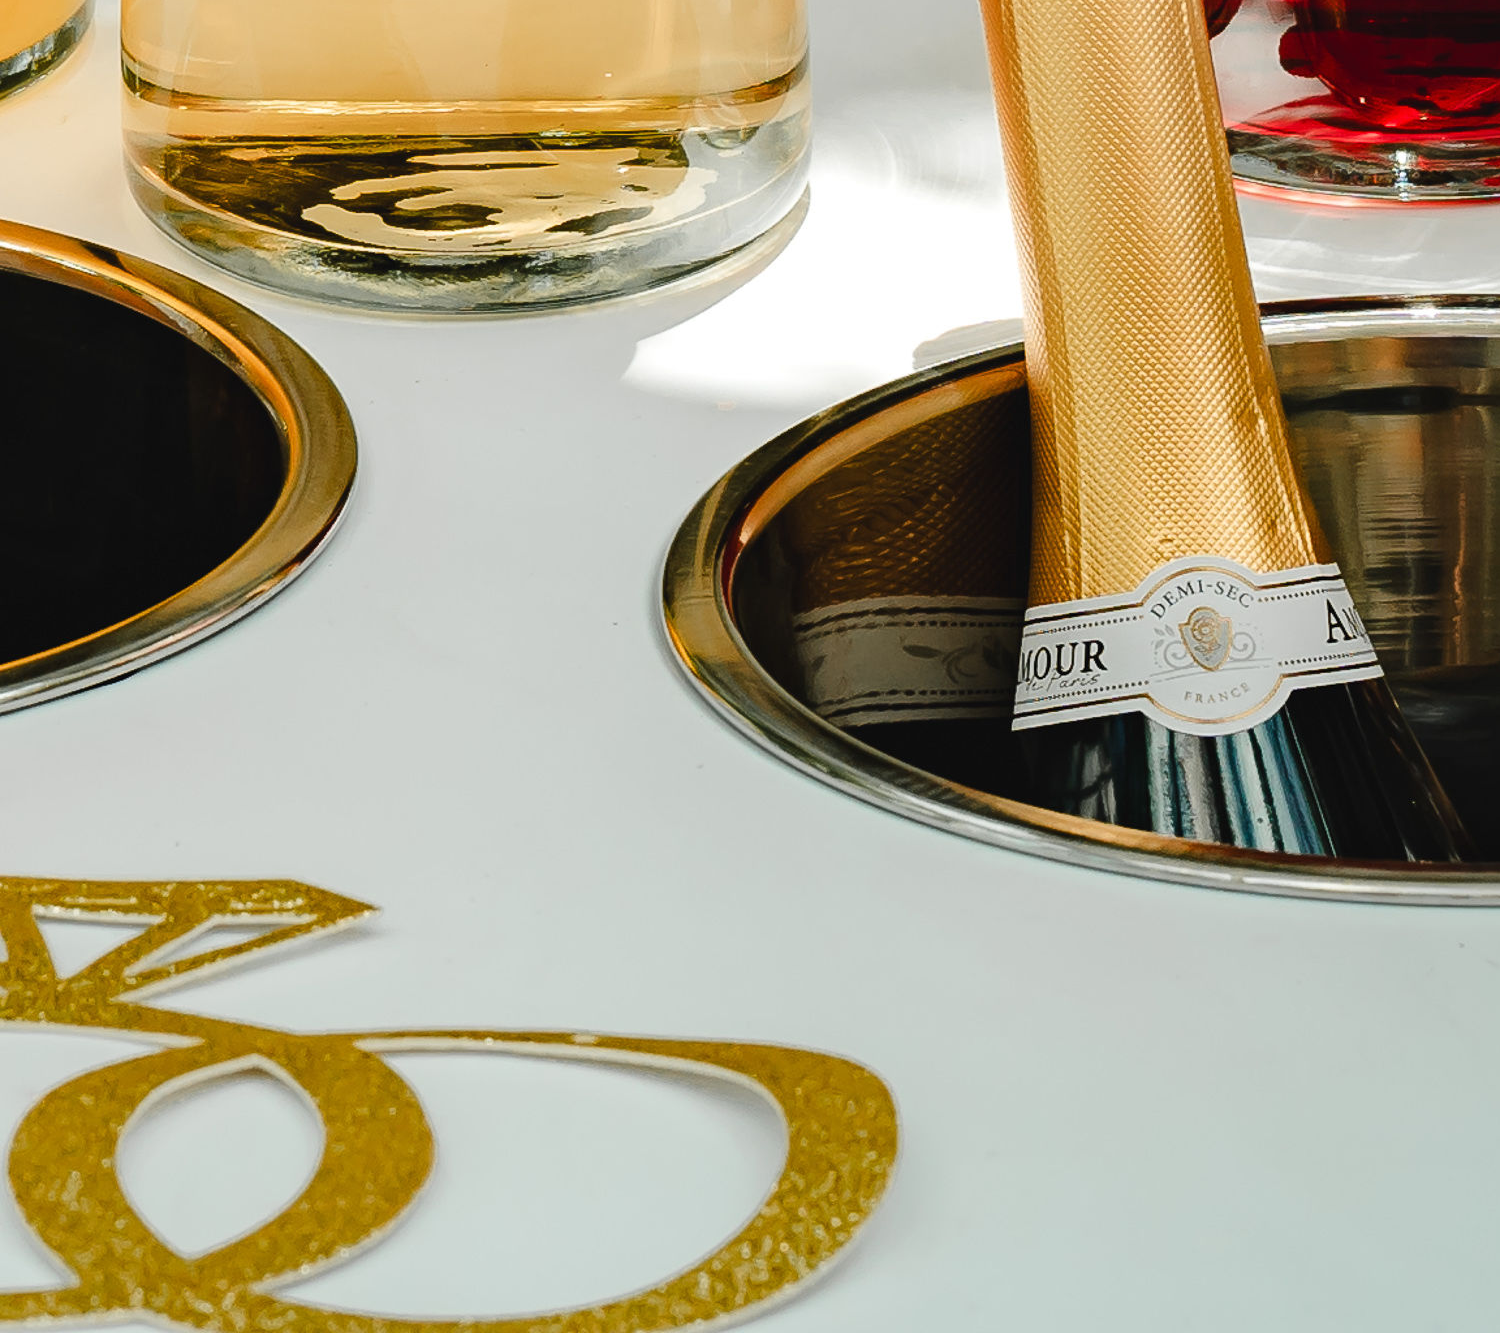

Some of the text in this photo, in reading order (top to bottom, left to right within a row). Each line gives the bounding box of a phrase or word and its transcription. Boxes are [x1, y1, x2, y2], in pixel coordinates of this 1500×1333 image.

[1150, 578, 1254, 621] DEMI-SEC
[1019, 639, 1109, 681] MOUR
[1183, 683, 1251, 704] FRANCE
